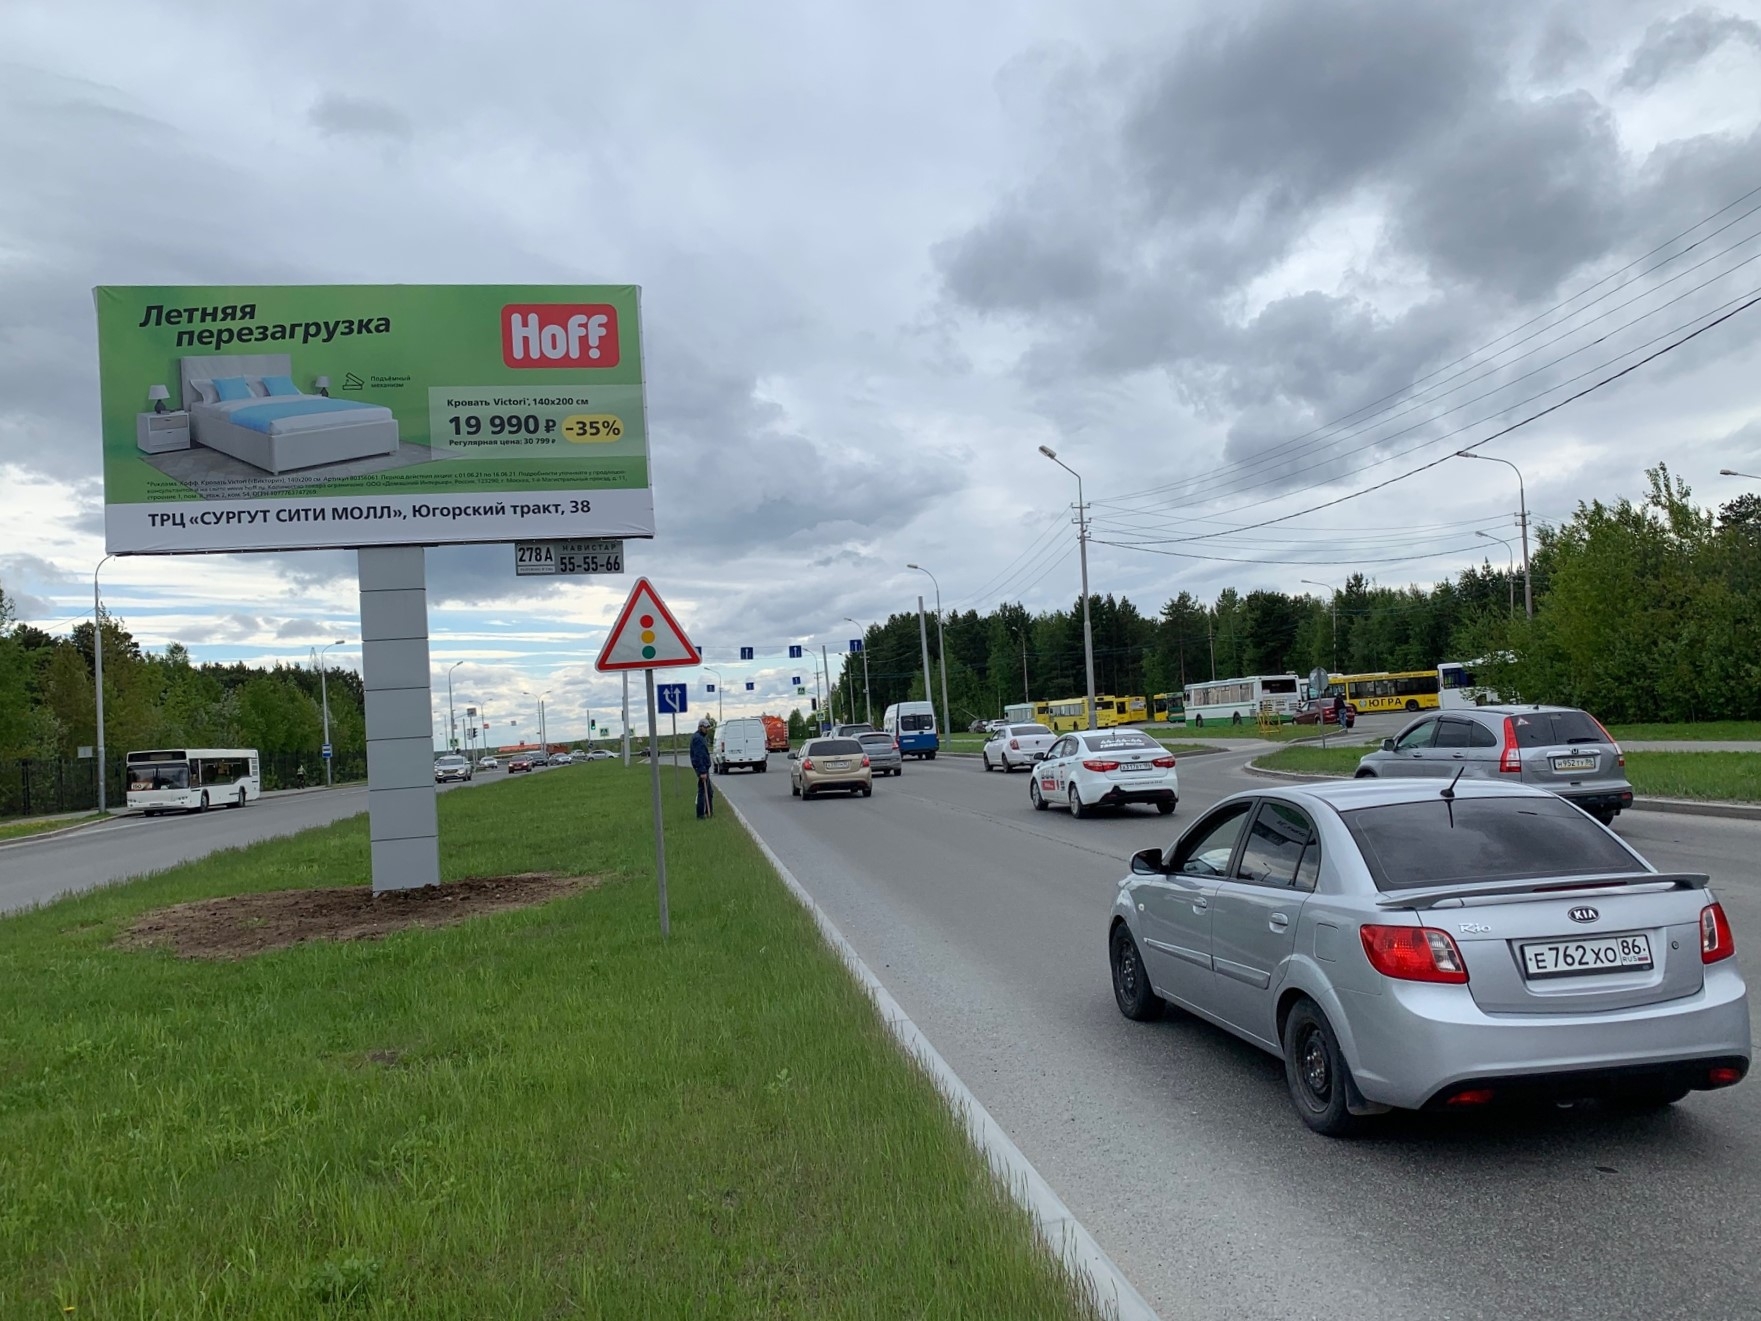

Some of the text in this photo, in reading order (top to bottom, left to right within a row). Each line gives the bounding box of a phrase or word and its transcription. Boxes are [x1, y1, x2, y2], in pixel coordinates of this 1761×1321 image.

[139, 303, 257, 328] Летняя
[175, 316, 391, 351] перезагрузка
[447, 399, 491, 408] Кровать
[448, 415, 482, 436] 19
[489, 414, 540, 435] 990
[449, 439, 498, 447] Регулярная
[148, 500, 591, 528] ТРЦ «СУРГУТ СИТИ МОЛЛ», Югорский тракт, 38
[562, 544, 617, 552] НАВИСТАР
[559, 555, 620, 573] 55-55-66
[1368, 697, 1402, 707] ЮГРА
[1573, 909, 1597, 919] KIA
[1458, 923, 1491, 934] Rio
[1534, 939, 1642, 970] Е762ХО 86
